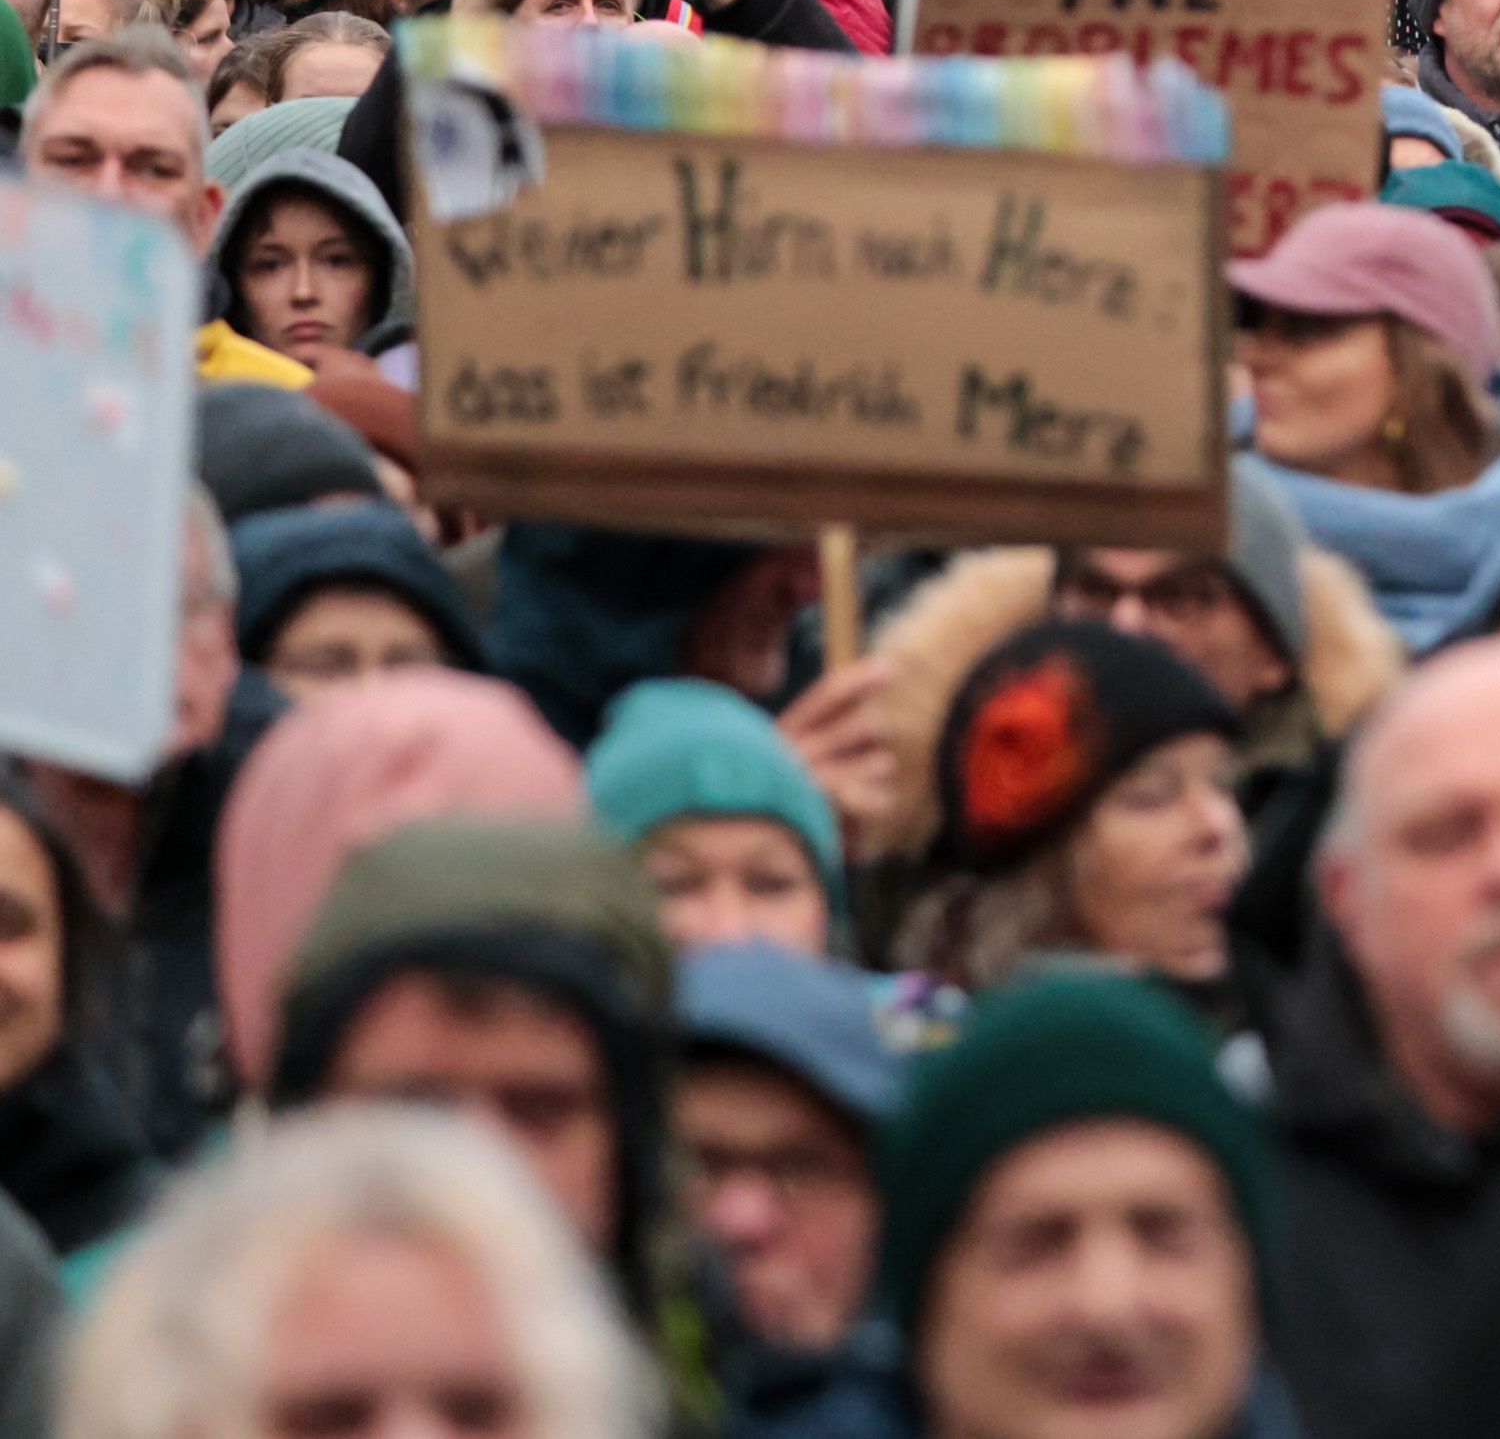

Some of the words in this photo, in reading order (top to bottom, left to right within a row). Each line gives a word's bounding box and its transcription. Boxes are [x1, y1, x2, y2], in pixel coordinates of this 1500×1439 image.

[446, 354, 560, 426] das
[674, 338, 924, 433] Friedrich
[954, 360, 1150, 476] Merz
